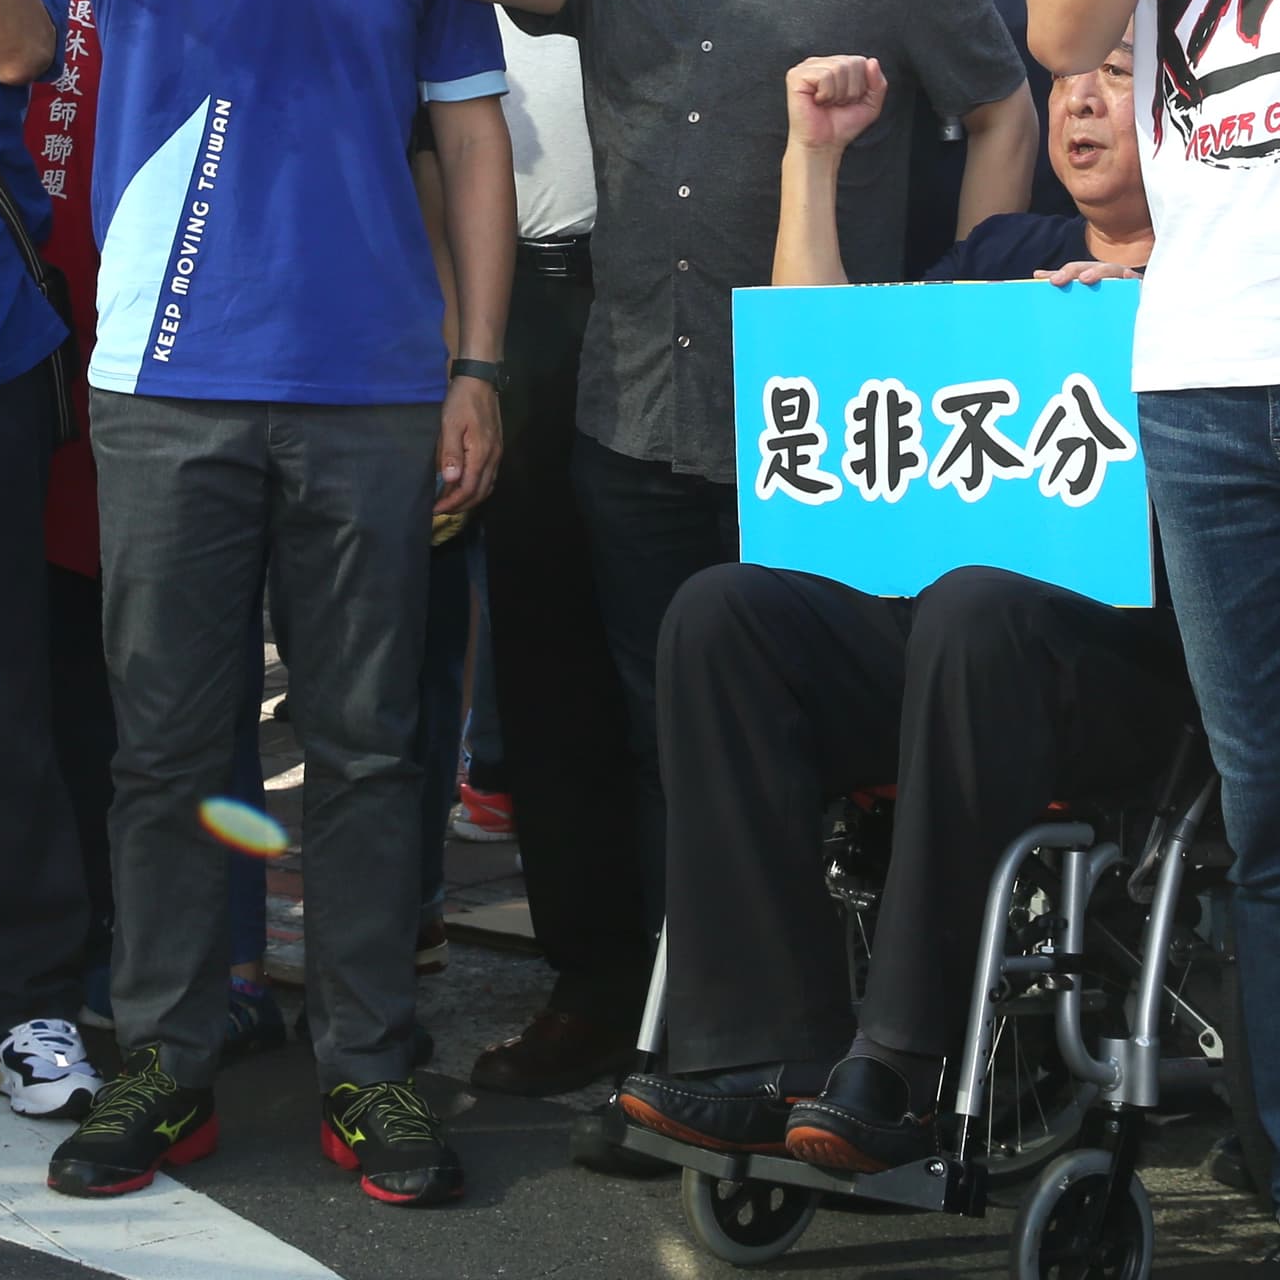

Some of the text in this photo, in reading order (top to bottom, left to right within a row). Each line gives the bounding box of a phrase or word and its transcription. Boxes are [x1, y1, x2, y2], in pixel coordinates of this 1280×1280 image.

[152, 99, 232, 363] KEEP MOVING TAIWAN
[764, 383, 1127, 496] 是非不分
